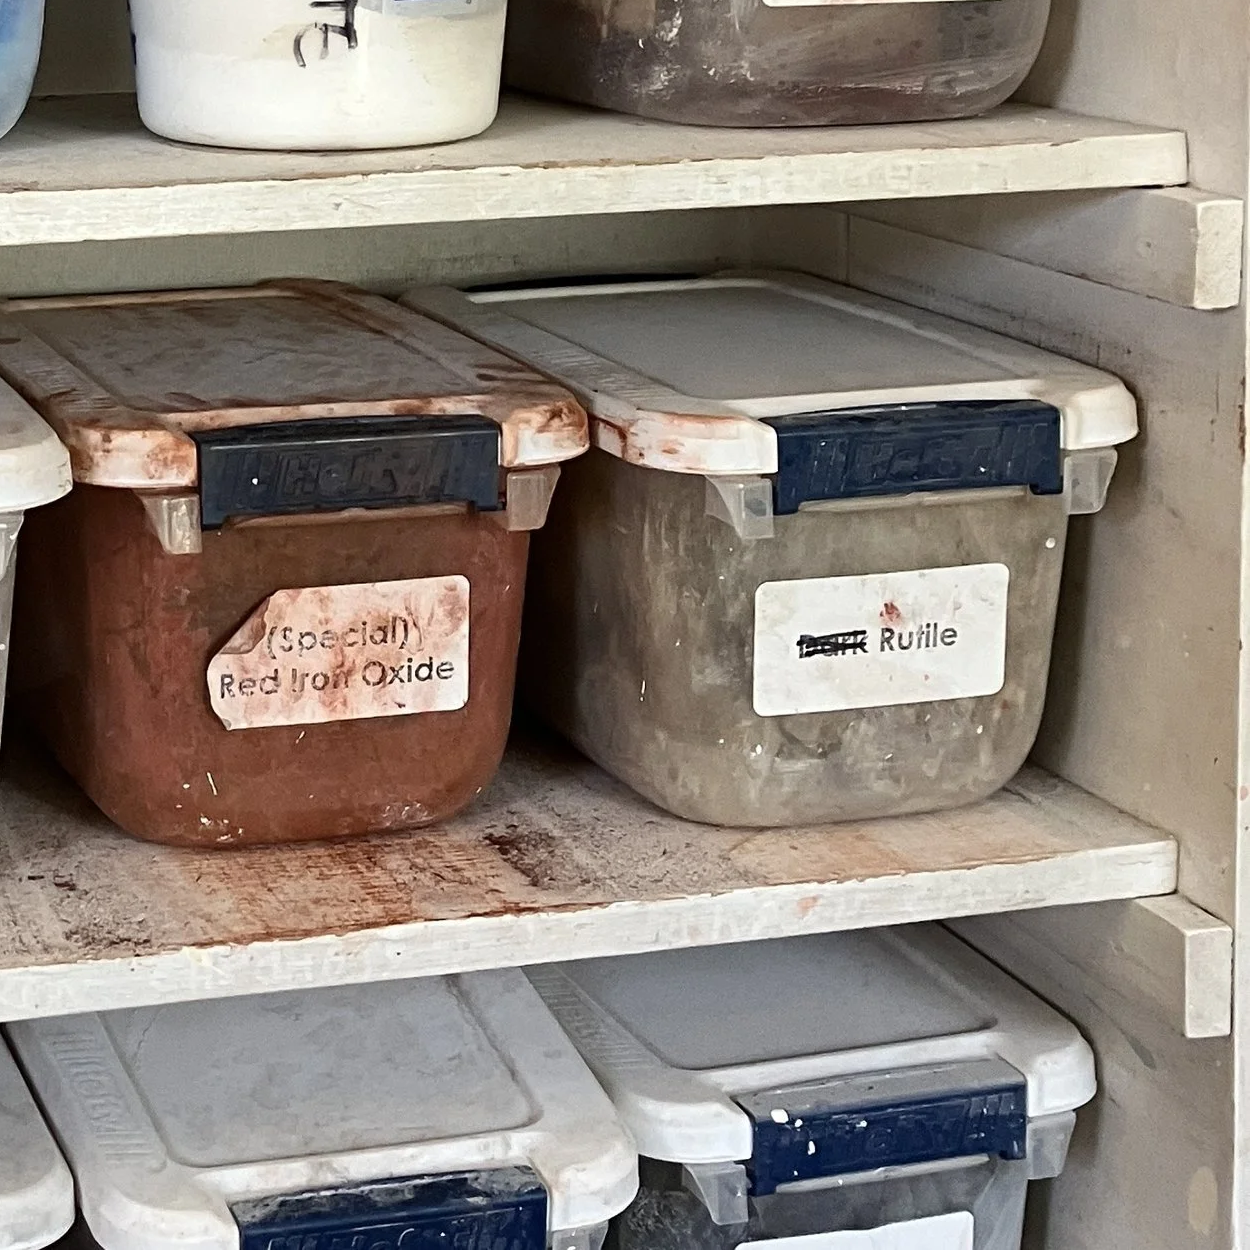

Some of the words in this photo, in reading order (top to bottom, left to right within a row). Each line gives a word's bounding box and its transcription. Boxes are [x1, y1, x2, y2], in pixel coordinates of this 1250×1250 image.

[266, 615, 411, 660] (Special)
[879, 622, 959, 652] Rutile
[219, 667, 282, 700] Red
[290, 665, 351, 694] Iron
[361, 656, 456, 688] Oxide
